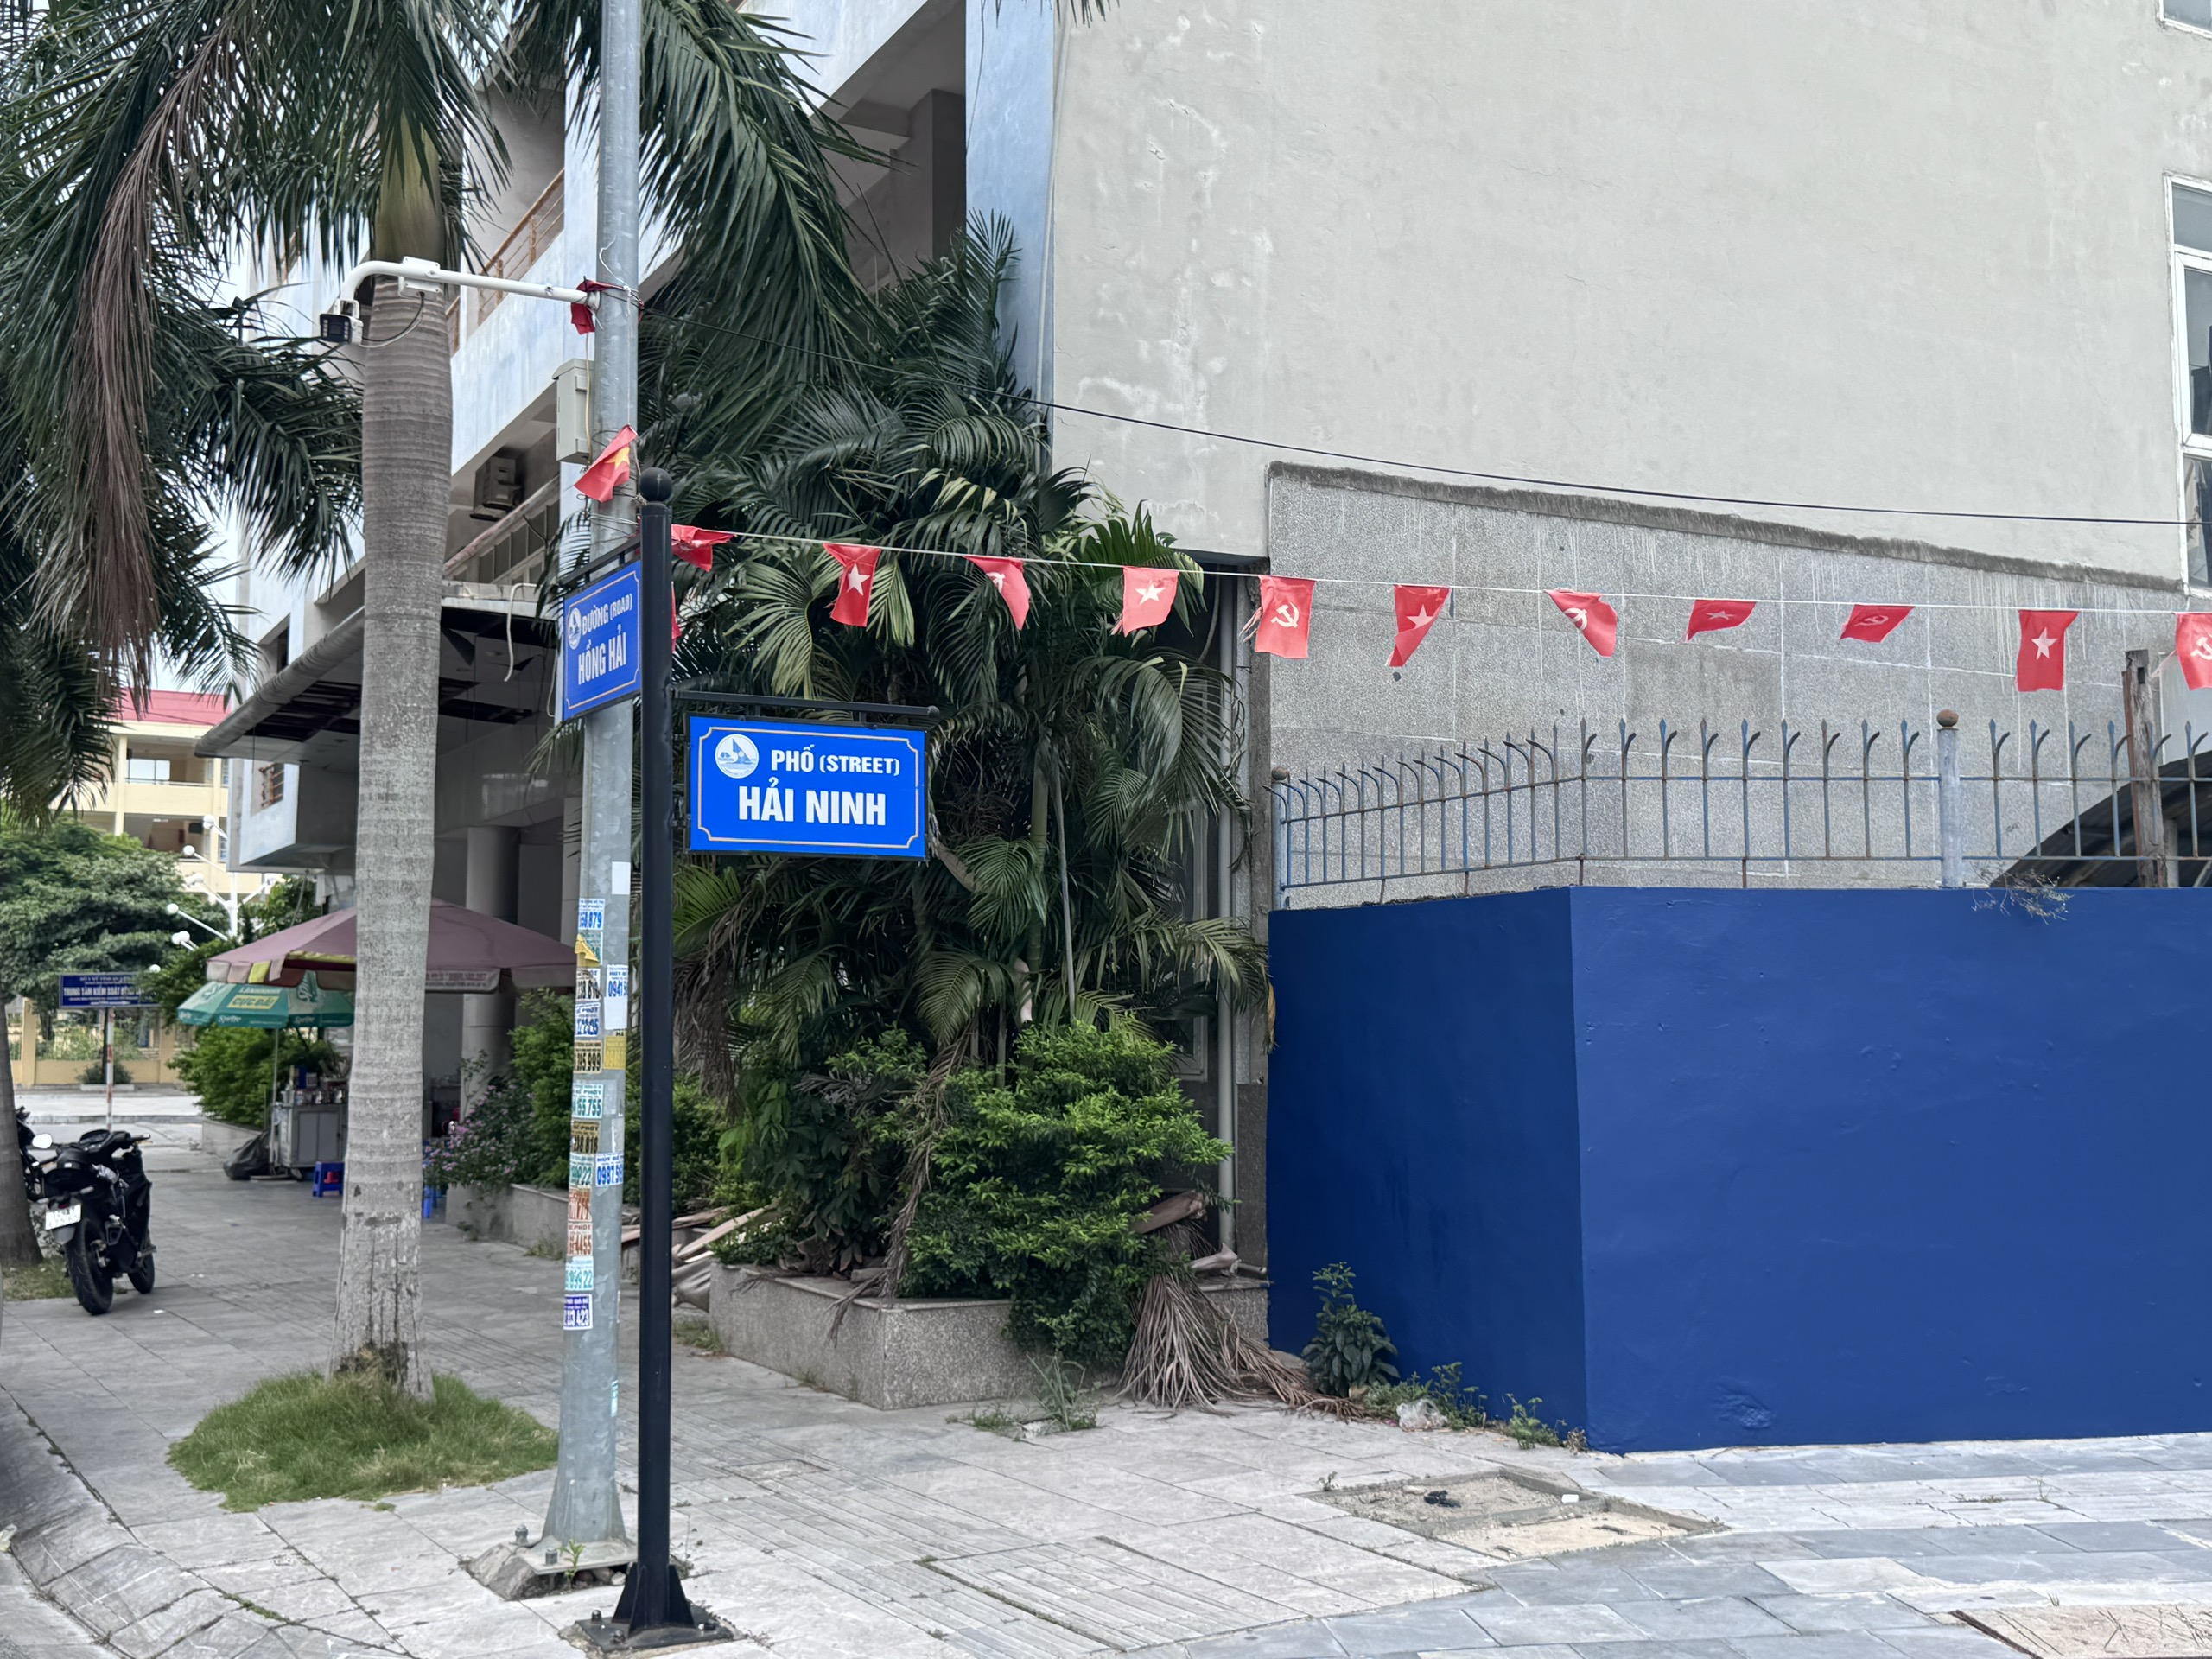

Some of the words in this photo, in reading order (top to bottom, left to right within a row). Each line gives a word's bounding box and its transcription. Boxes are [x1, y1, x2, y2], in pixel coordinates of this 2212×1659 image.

[582, 603, 609, 635] ĐƯỜNG
[610, 594, 632, 620] (ROAD)
[578, 639, 606, 685] HỒNG
[608, 624, 626, 671] HẢI
[771, 744, 815, 772] PHỐ
[819, 754, 900, 776] (STREET)
[739, 777, 794, 822] HẢI
[806, 790, 886, 826] NINH
[219, 1014, 242, 1024] Sprite
